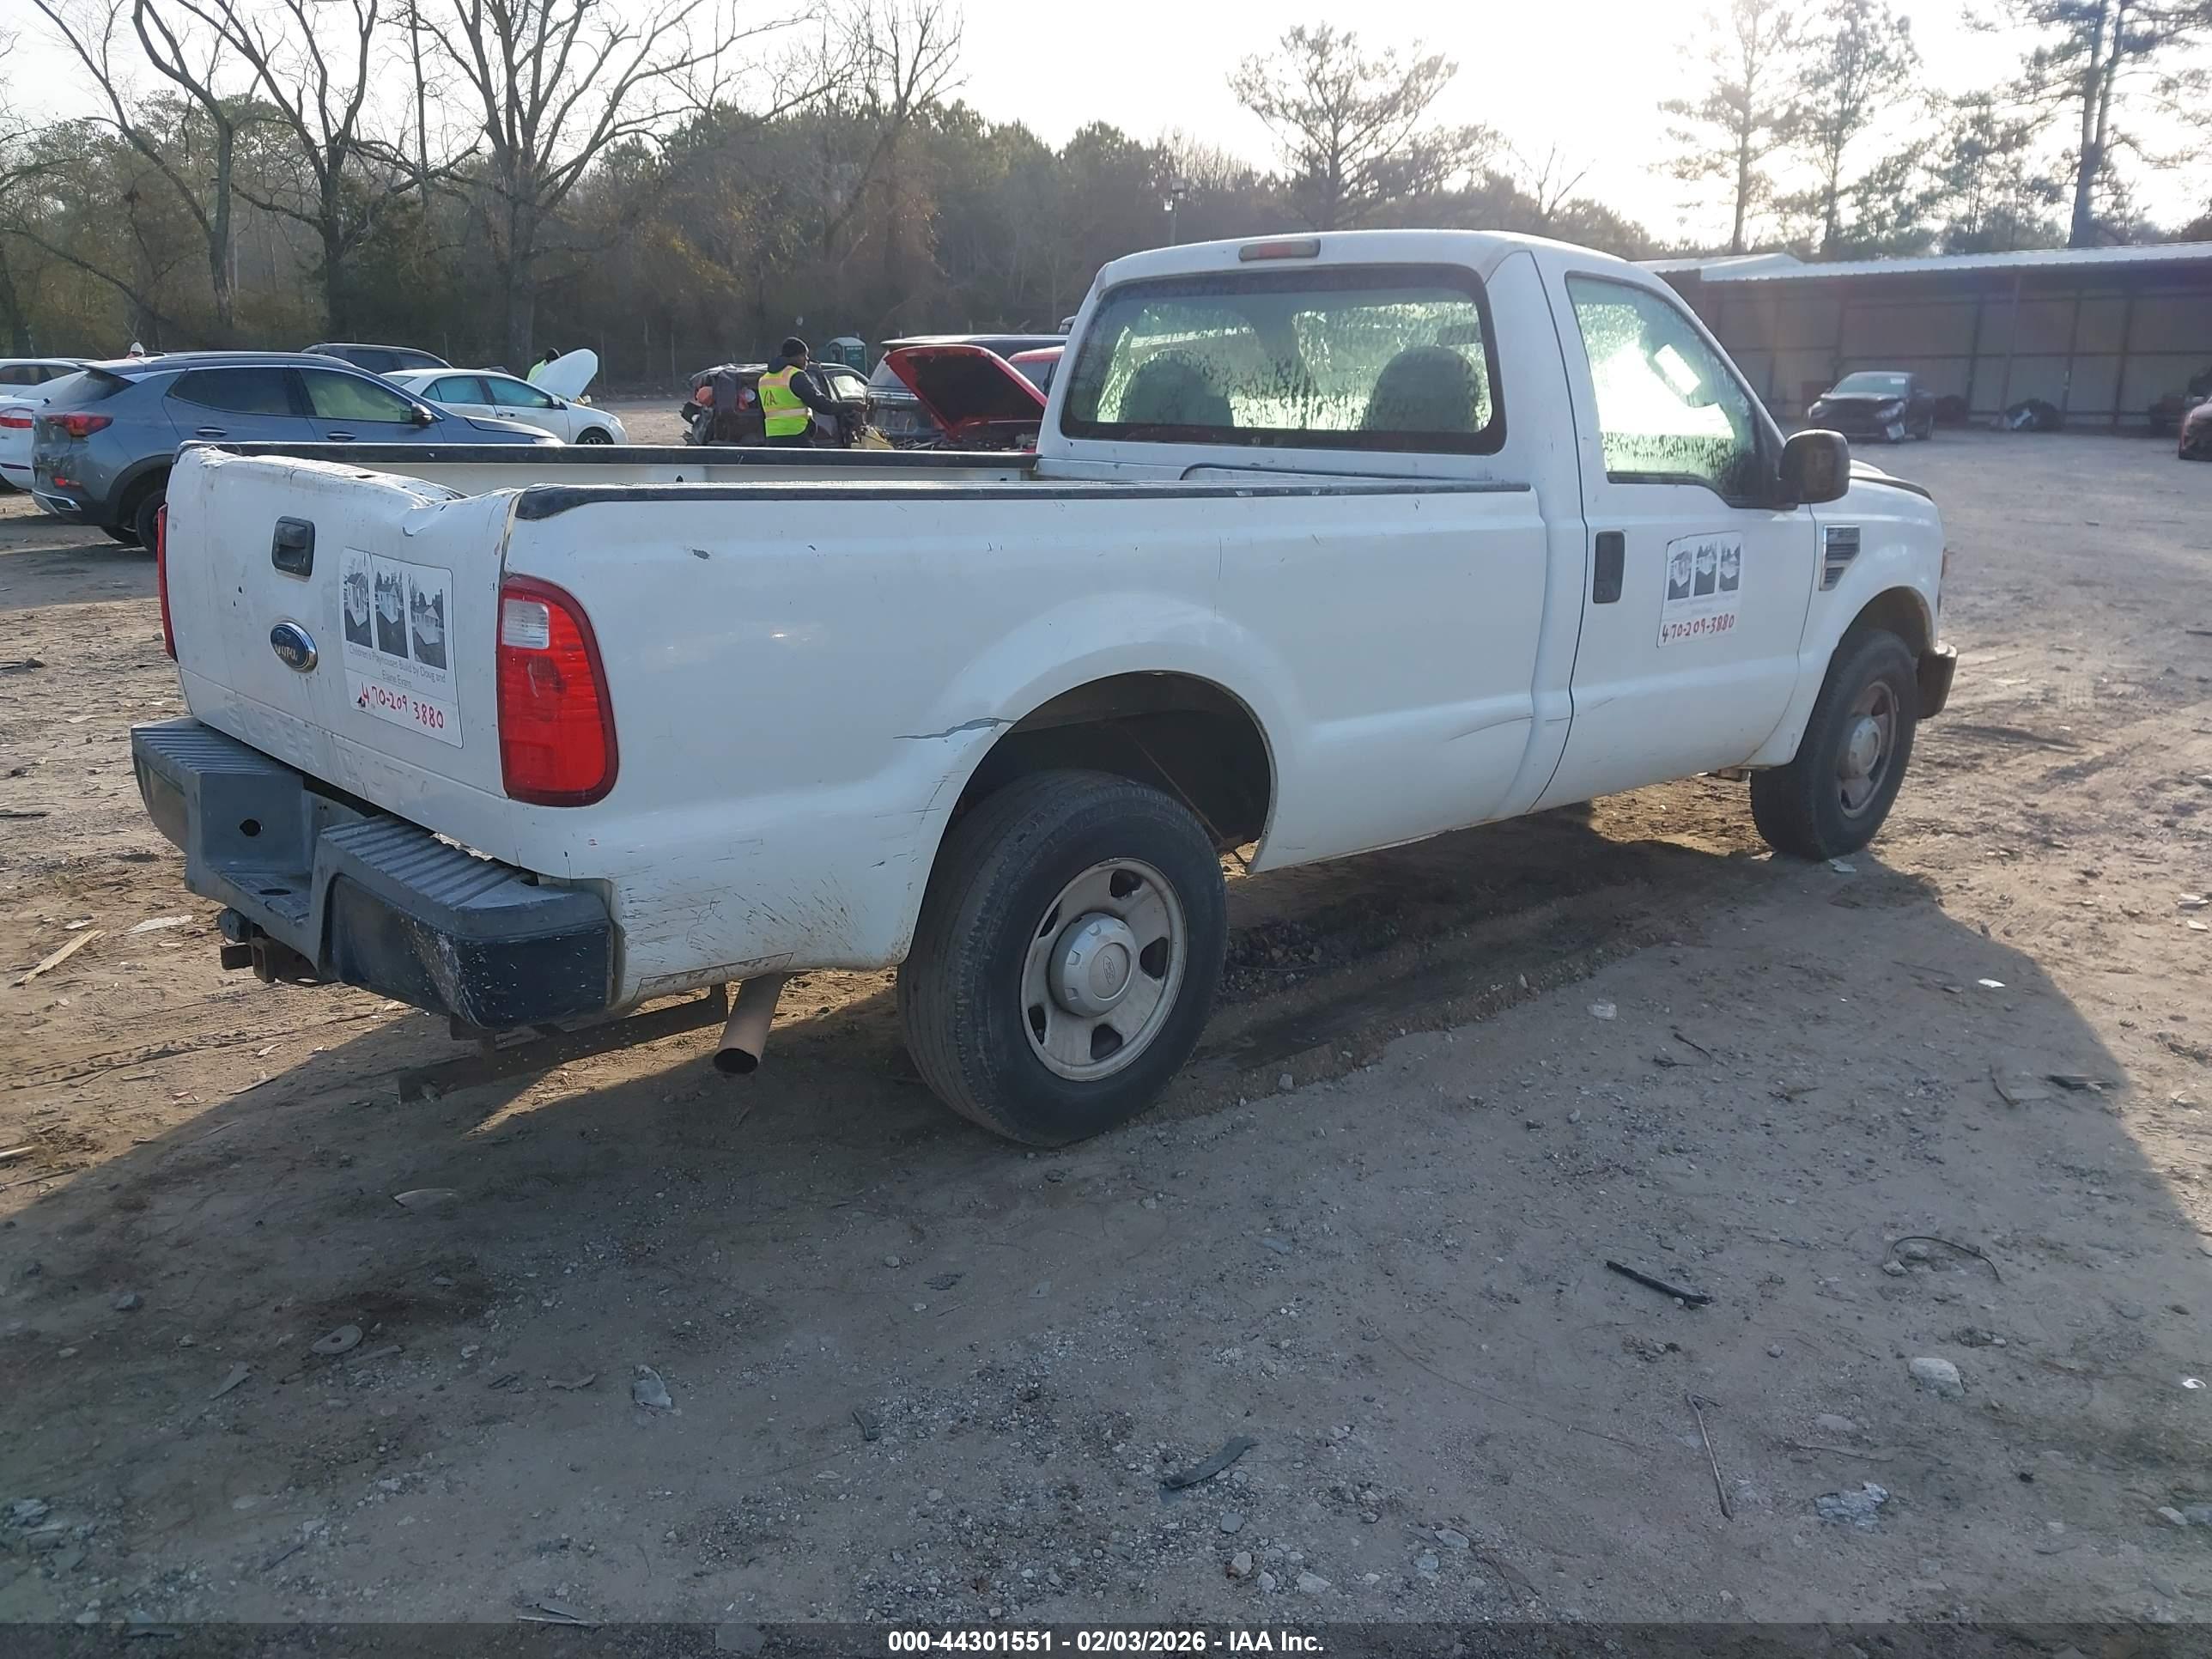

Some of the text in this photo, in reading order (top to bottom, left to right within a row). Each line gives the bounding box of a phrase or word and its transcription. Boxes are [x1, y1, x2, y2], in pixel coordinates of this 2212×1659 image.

[1662, 613, 1735, 643] 470-209-3880
[420, 666, 435, 684] Doug
[436, 672, 446, 684] and
[412, 701, 444, 729] 3880
